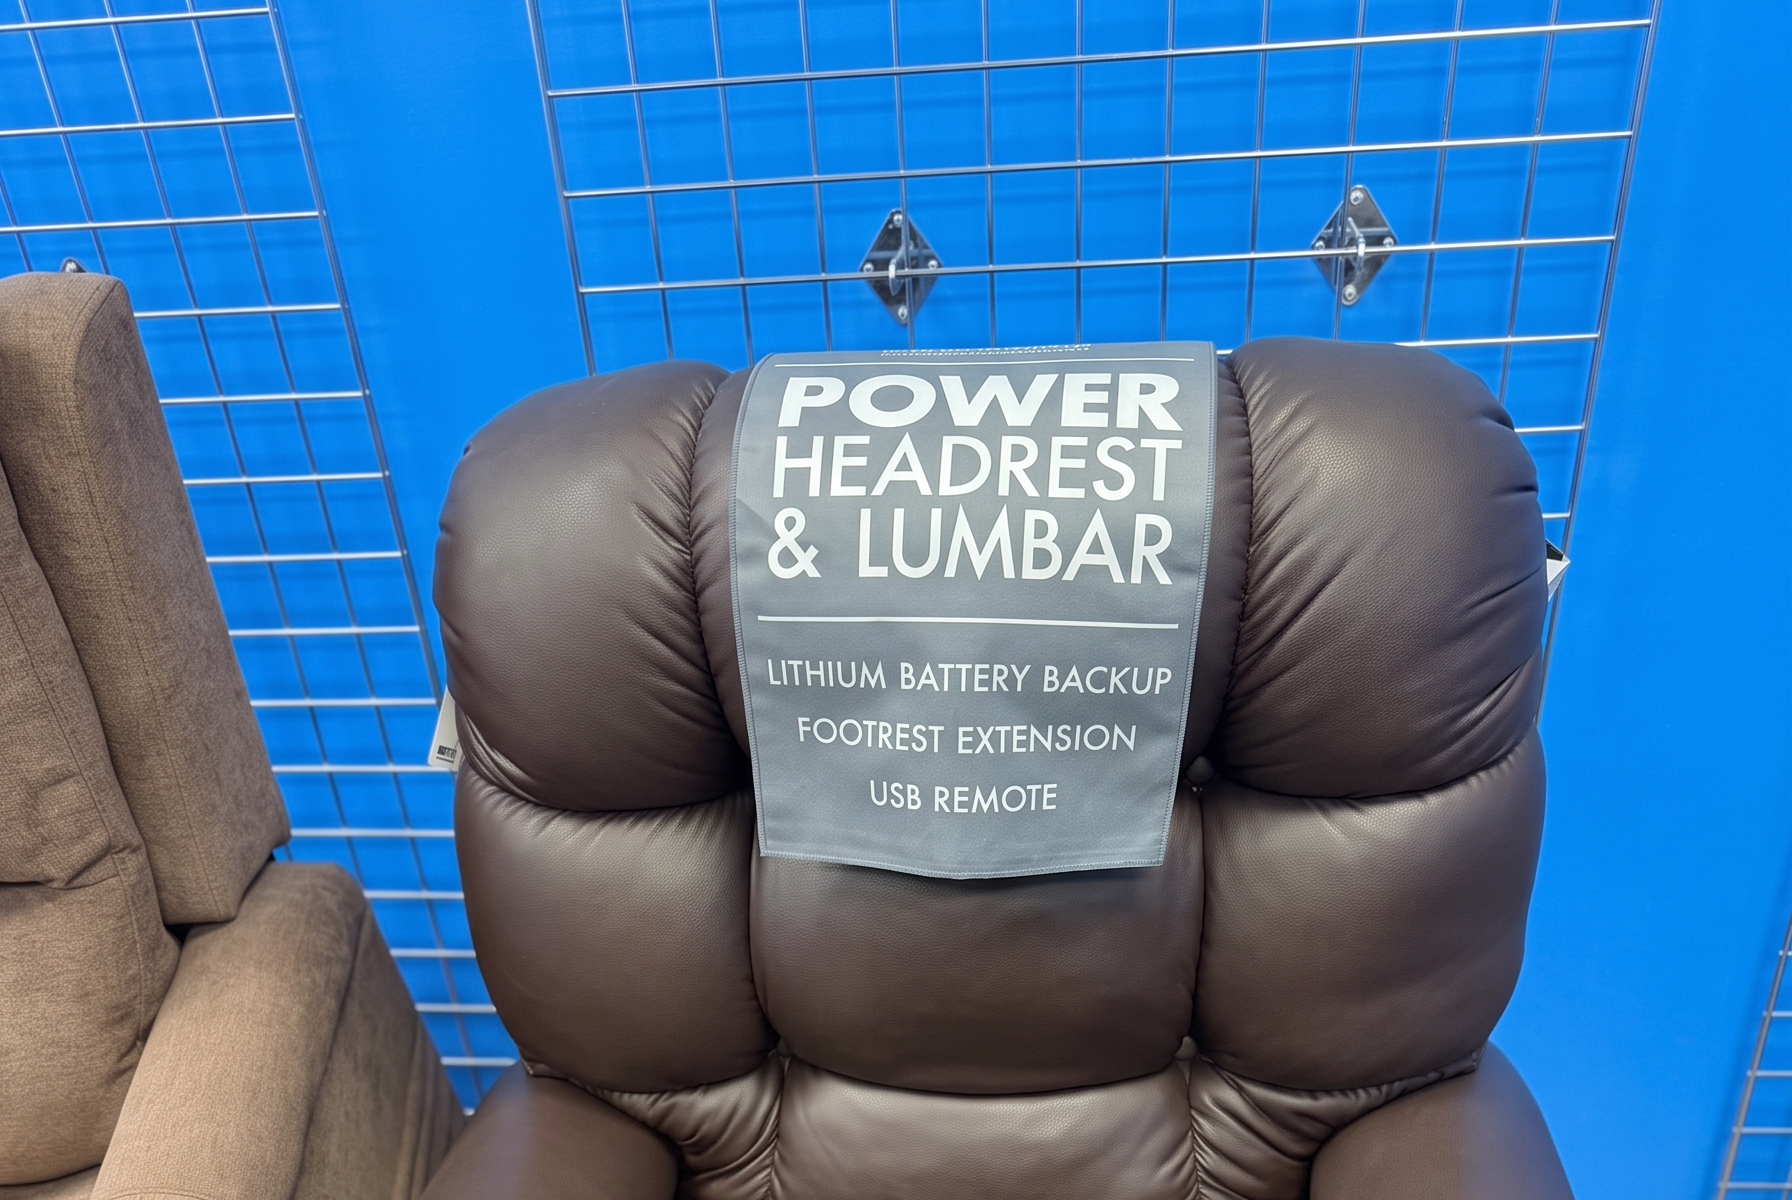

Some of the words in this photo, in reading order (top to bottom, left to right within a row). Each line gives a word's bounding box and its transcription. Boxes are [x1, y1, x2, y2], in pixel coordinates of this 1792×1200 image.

[777, 373, 1183, 431] POWER
[772, 432, 1182, 501] HEADREST
[767, 507, 821, 579] &
[858, 503, 1173, 585] LUMBAR
[767, 659, 886, 689] LITHIUM
[900, 662, 1030, 692] BATTERY
[1043, 665, 1172, 695] BACKUP
[798, 718, 944, 752] FOOTREST
[957, 725, 1136, 754] EXTENSION
[869, 780, 922, 810] USB
[934, 783, 1057, 813] REMOTE
